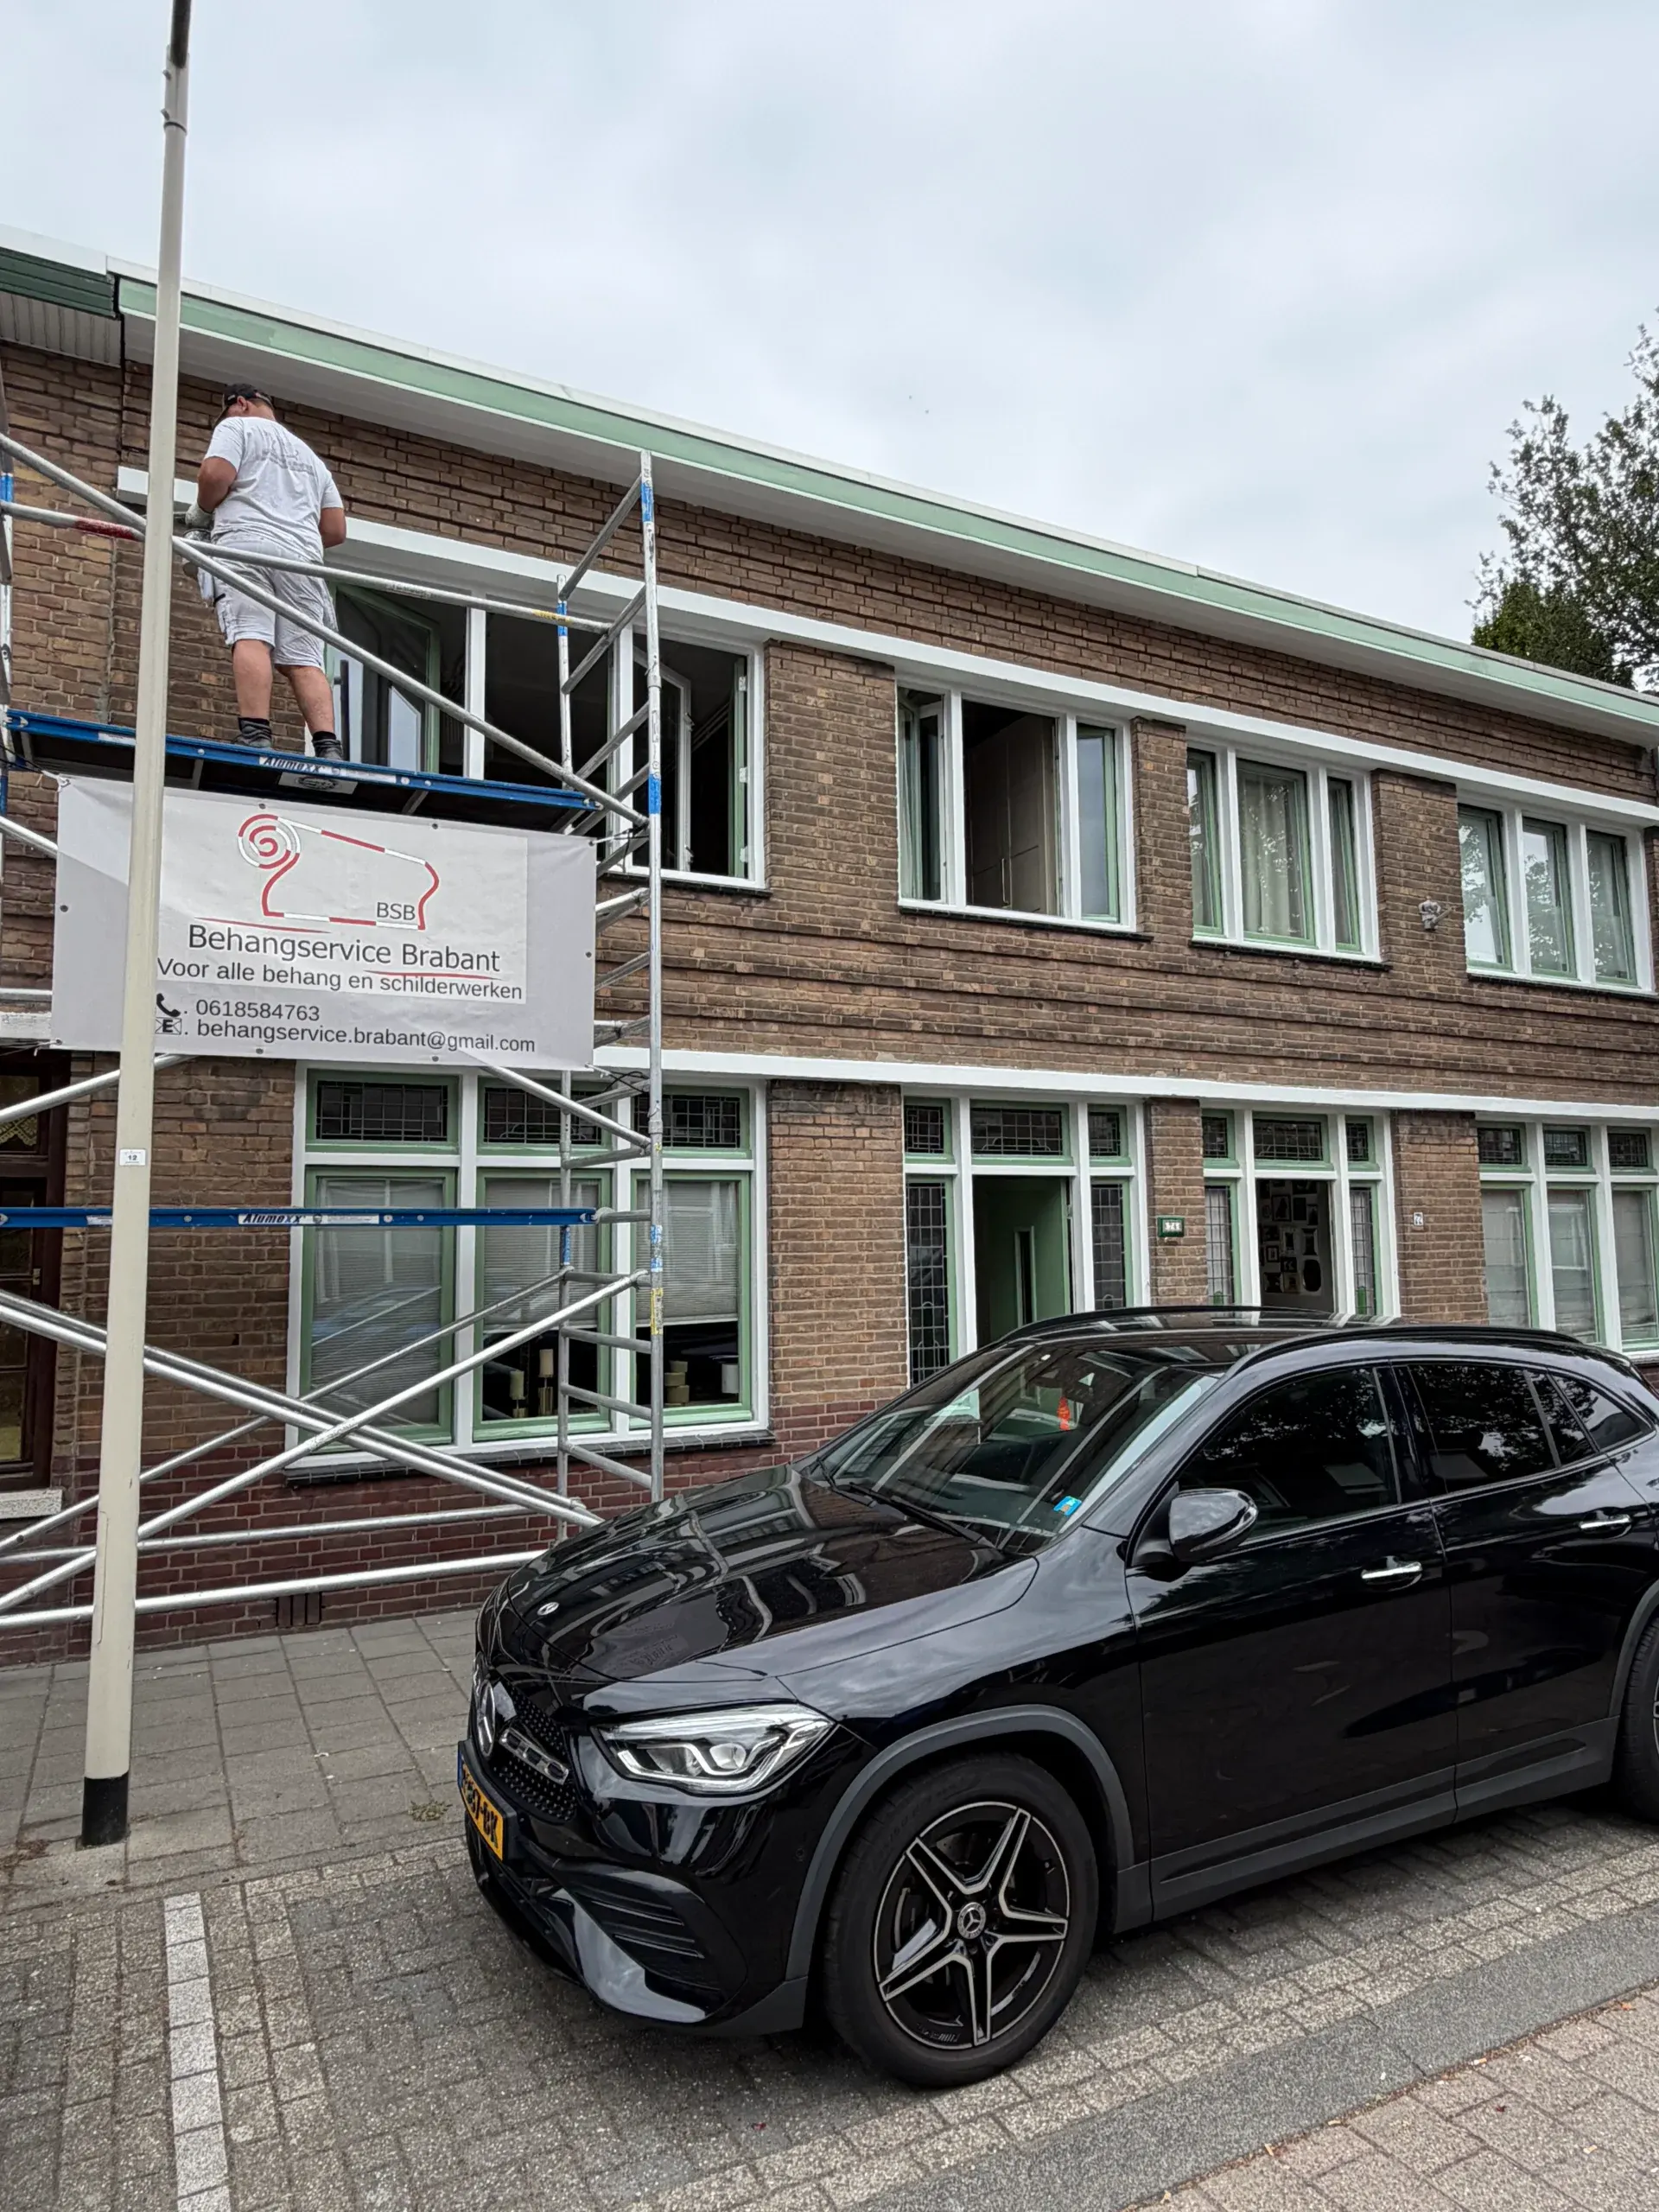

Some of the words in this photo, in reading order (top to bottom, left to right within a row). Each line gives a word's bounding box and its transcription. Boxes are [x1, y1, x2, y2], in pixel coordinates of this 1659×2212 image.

[376, 901, 416, 921] BSB
[188, 925, 391, 967] Behangservice
[402, 943, 500, 972] Brabant
[157, 957, 210, 977] Voor
[217, 962, 255, 982] alle
[263, 964, 341, 991] behang
[348, 975, 373, 989] en
[379, 974, 522, 1000] schilderwerken
[195, 999, 320, 1021] 0618584763
[197, 1019, 536, 1052] behangservice.brabant@gmail.com
